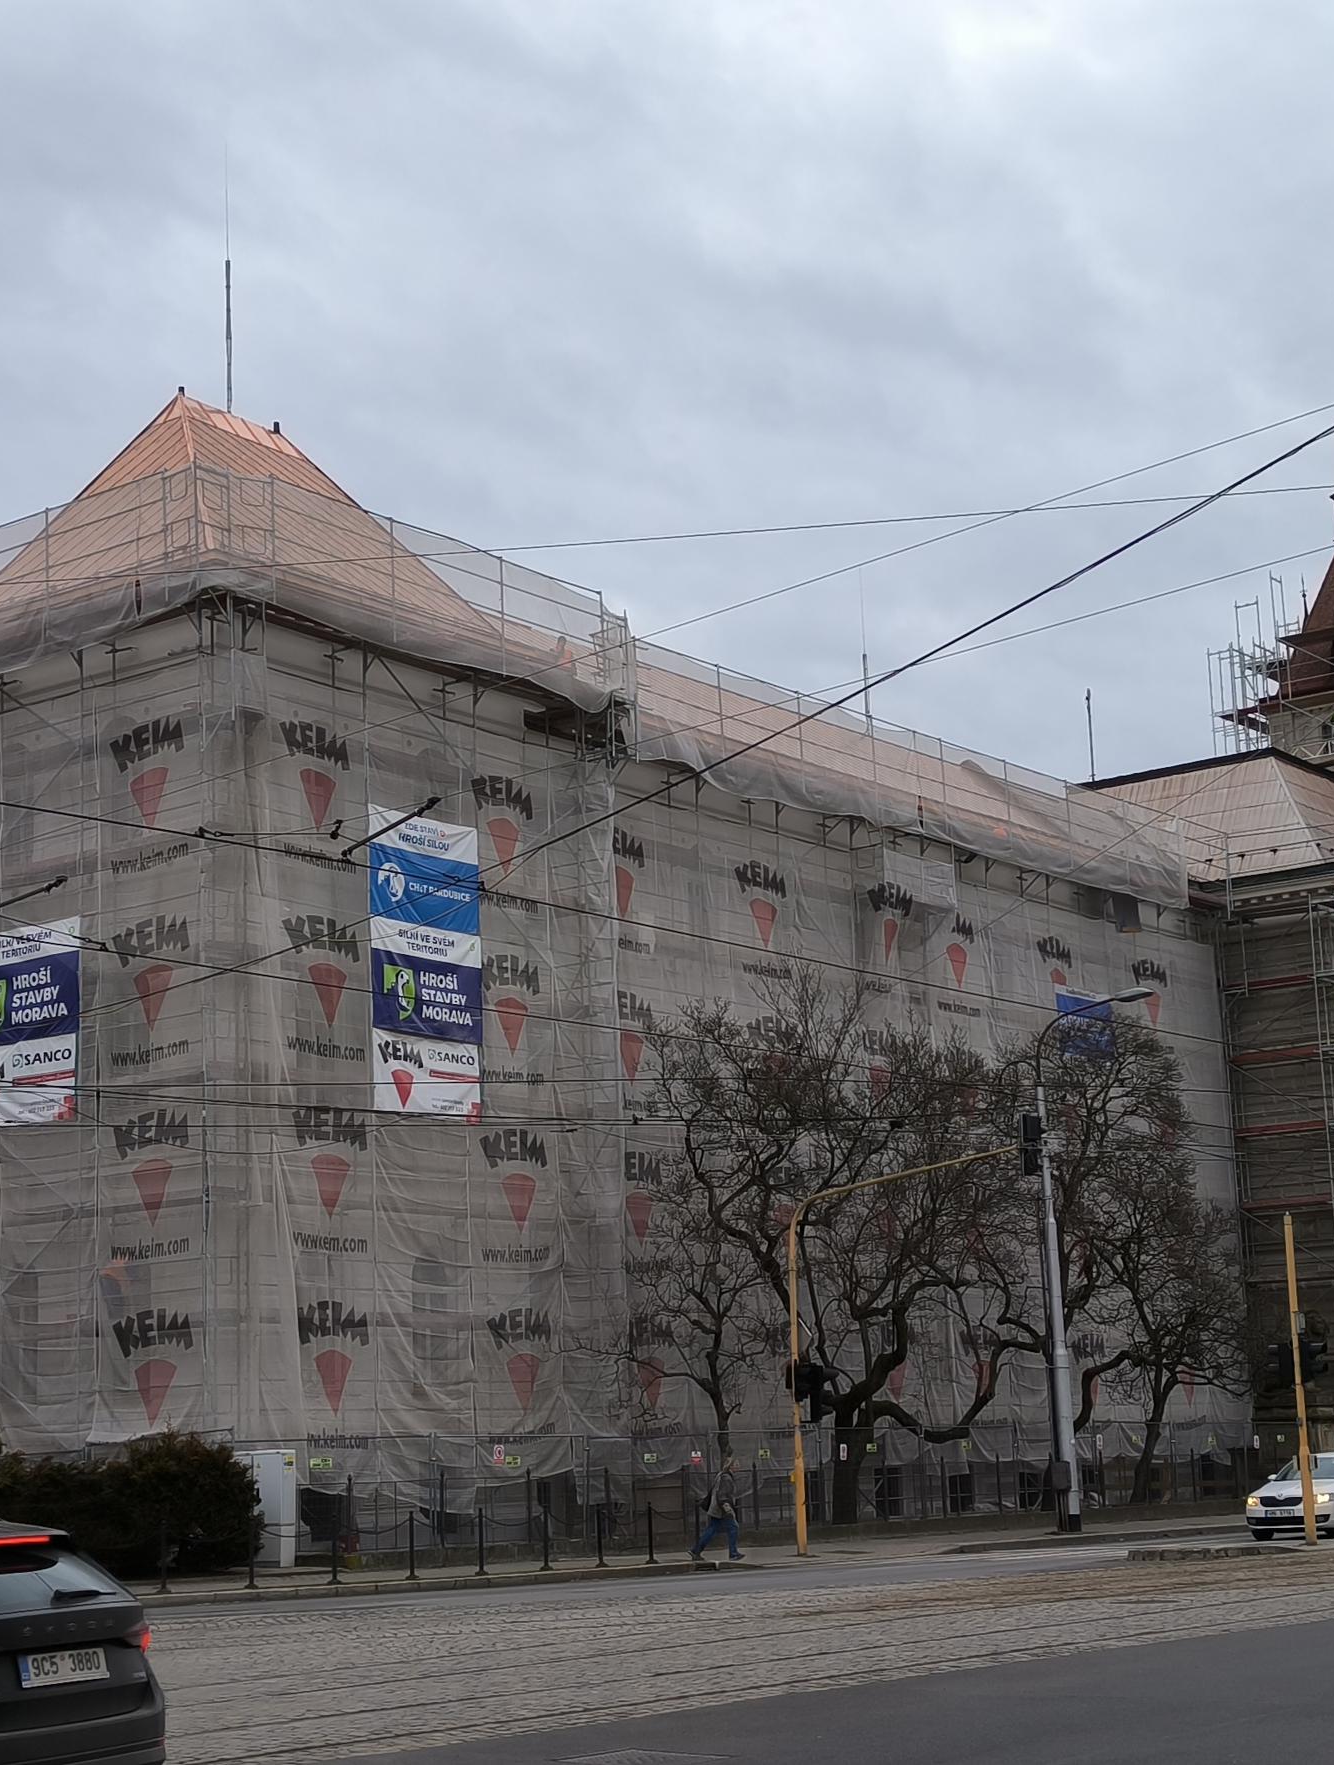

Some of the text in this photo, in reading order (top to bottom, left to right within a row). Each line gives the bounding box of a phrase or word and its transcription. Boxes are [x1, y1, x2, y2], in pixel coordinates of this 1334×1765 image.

[109, 715, 185, 773] KEIM
[279, 720, 350, 771] KEIM
[471, 775, 533, 820] KEIM
[398, 832, 450, 851] HROŠÍ SILOU
[612, 826, 645, 868] EIM
[111, 841, 189, 875] www.keim.com
[734, 859, 787, 899] KEIM
[112, 913, 190, 968] KEIM
[282, 914, 360, 963] KEIM
[406, 941, 448, 957] TERITORIU
[420, 934, 431, 943] VE
[432, 935, 455, 948] SVÉM
[12, 966, 51, 990] HROŠÍ
[420, 970, 458, 990] HROŠÍ
[11, 985, 60, 1008] STAVBY
[421, 988, 467, 1006] STAVBY
[617, 990, 653, 1025] EIM
[11, 1002, 68, 1025] MORAVA
[421, 1004, 473, 1026] MORAVA
[24, 1048, 72, 1066] SANCO
[111, 1038, 189, 1068] www.keim.com
[287, 1034, 365, 1063] www.keim.com
[378, 1040, 424, 1069] KEIM
[437, 1051, 475, 1066] SANCO
[113, 1109, 191, 1159] KEIM
[292, 1107, 367, 1151] KEIM
[480, 1129, 548, 1169] KEIM
[111, 1236, 190, 1262] www.keim.com
[482, 1243, 550, 1264] www.keim.com
[113, 1308, 194, 1359] KEIM
[298, 1300, 370, 1346] KEIM
[486, 1307, 551, 1350] KEIM
[31, 1650, 101, 1678] 9C5 3880
